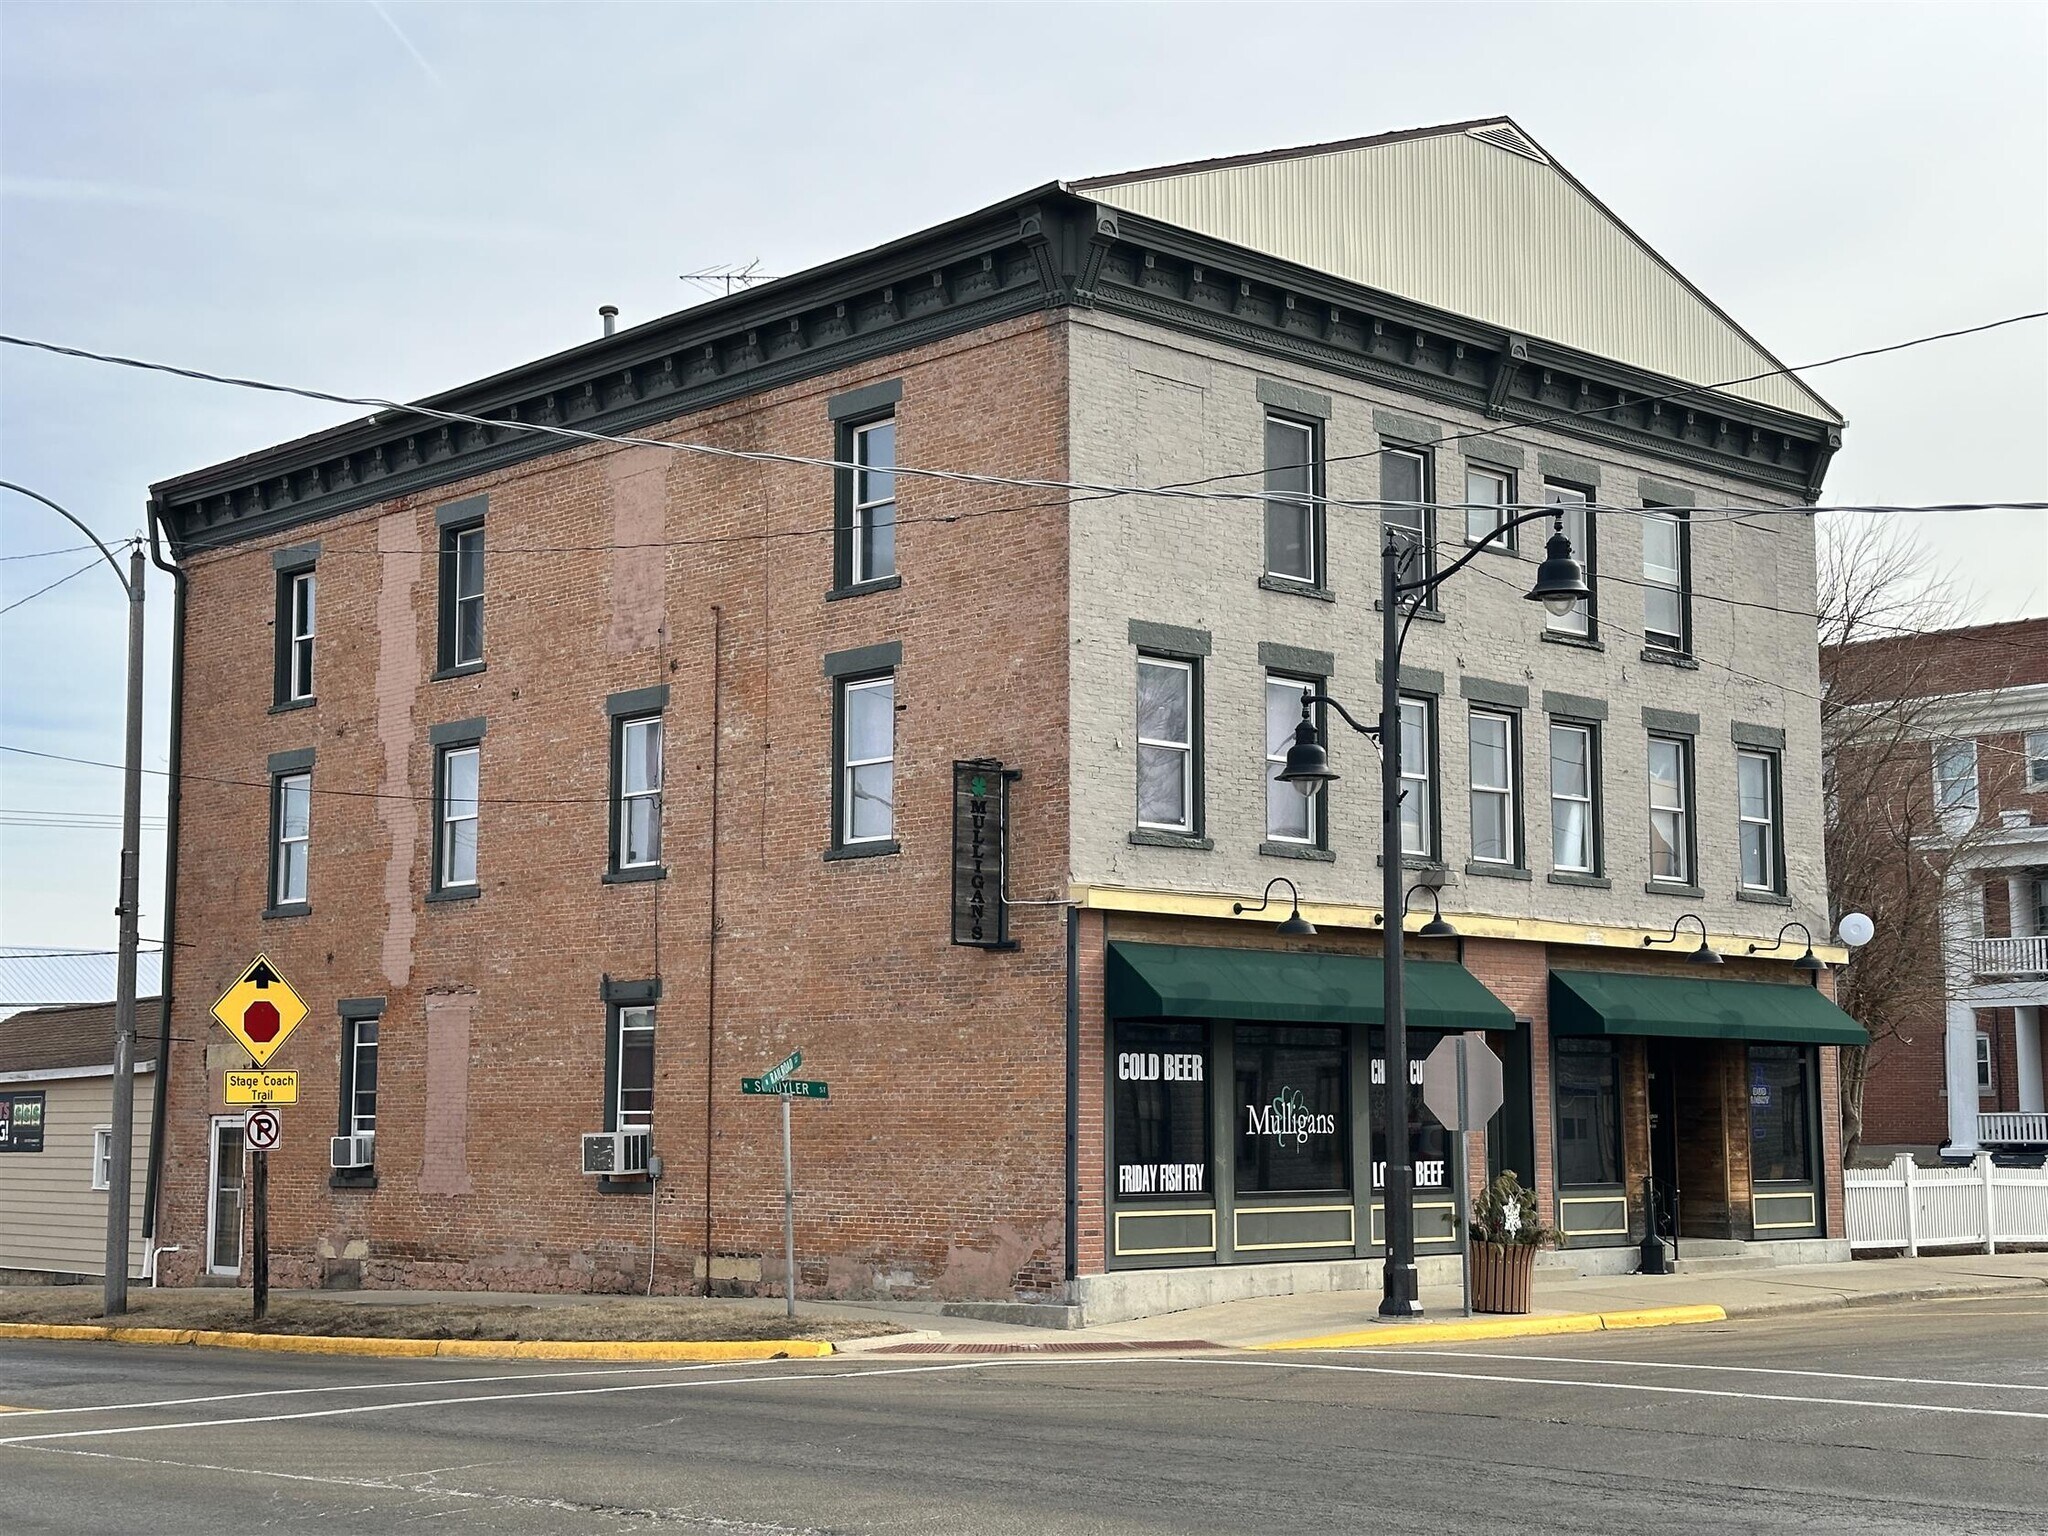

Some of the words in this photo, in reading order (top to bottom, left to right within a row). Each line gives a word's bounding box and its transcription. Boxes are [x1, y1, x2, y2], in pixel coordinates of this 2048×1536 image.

[970, 800, 987, 941] MULLIGAN'S
[1118, 1052, 1160, 1081] COLD
[1163, 1053, 1204, 1082] BEER
[230, 1075, 259, 1089] Stage
[263, 1075, 294, 1087] Coach
[252, 1089, 273, 1101] Trail
[754, 1080, 810, 1096] SUYLER
[819, 1086, 827, 1094] ST
[1245, 1101, 1335, 1144] Mulligans
[1119, 1164, 1158, 1193] FRIDAY
[1159, 1163, 1183, 1192] FISH
[1184, 1163, 1205, 1192] FRY
[1415, 1160, 1445, 1187] BEEF
